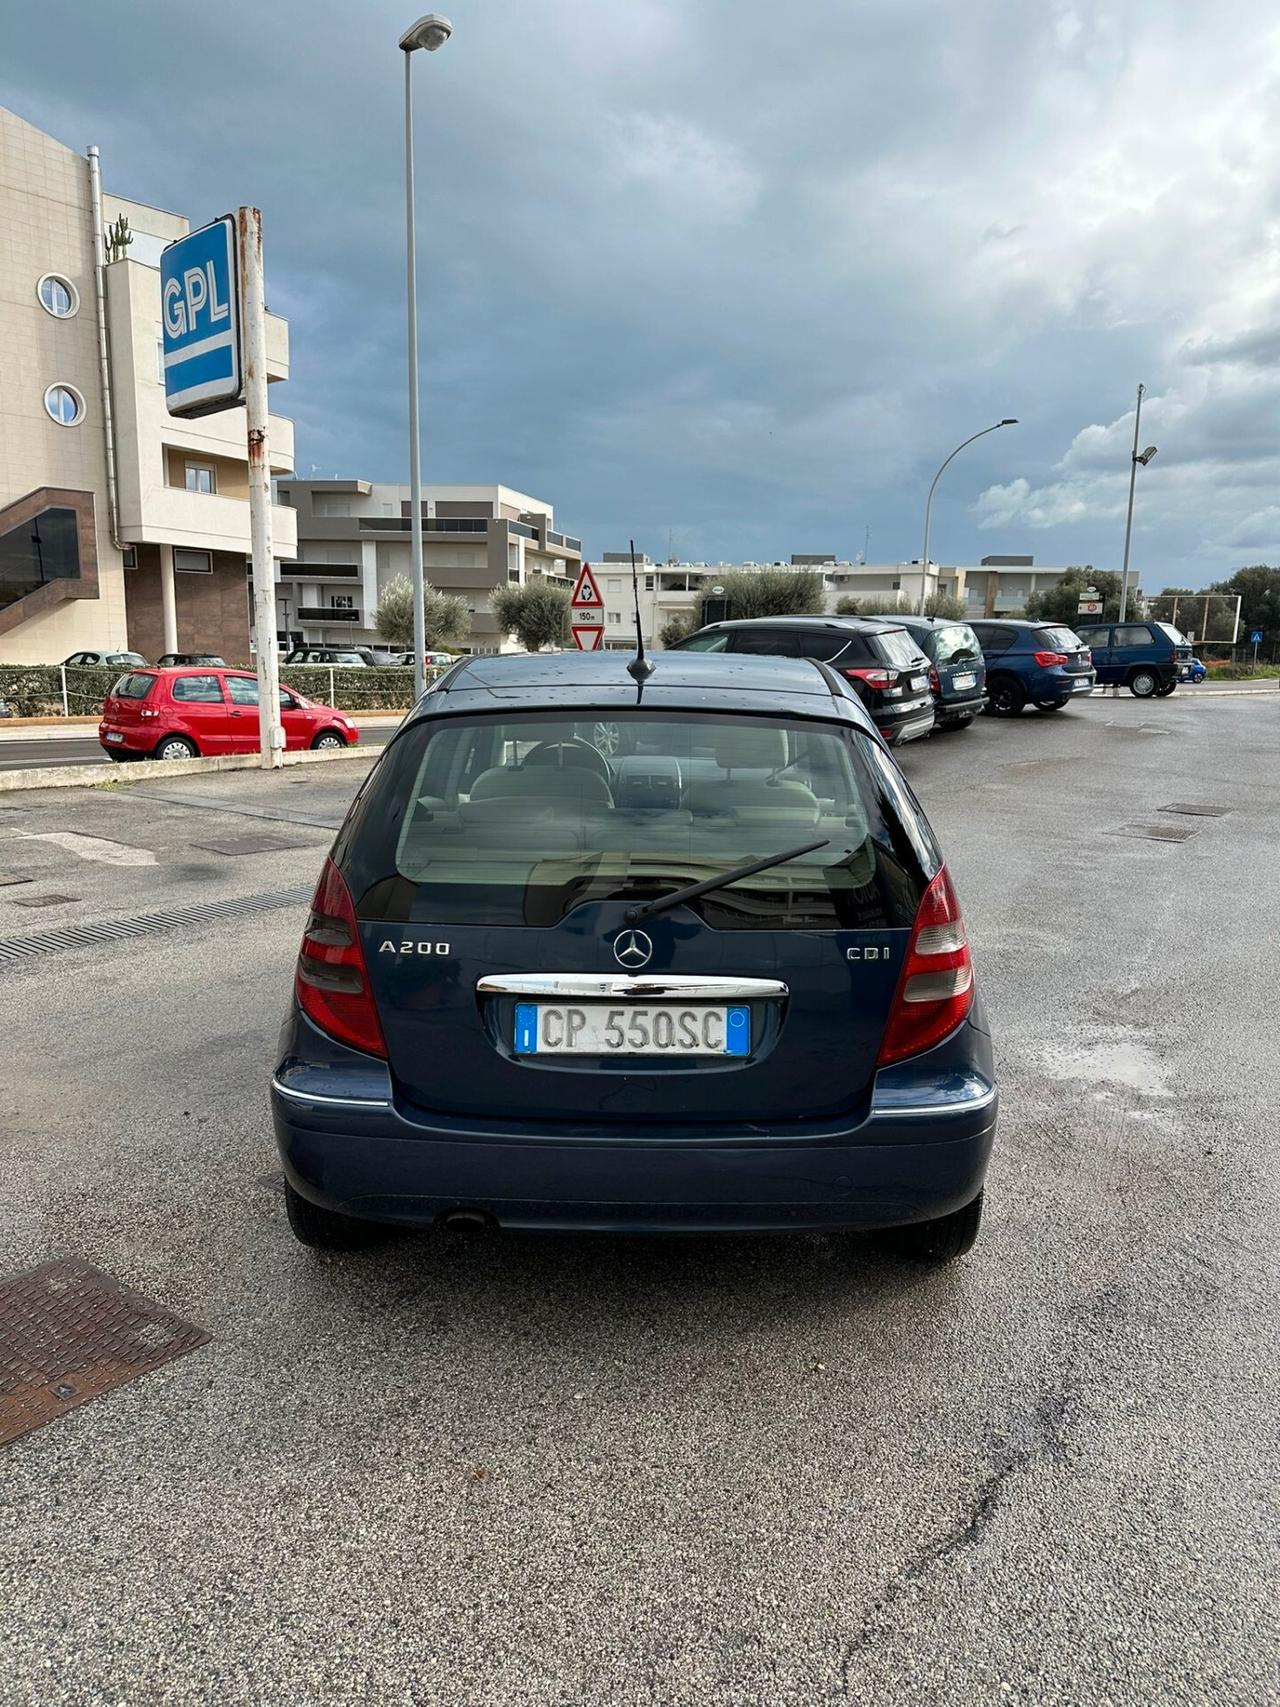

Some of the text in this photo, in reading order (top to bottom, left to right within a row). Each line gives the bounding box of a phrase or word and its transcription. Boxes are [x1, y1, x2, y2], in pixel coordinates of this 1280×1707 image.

[164, 260, 228, 339] GPL
[379, 940, 450, 955] A200
[847, 947, 889, 960] CDI
